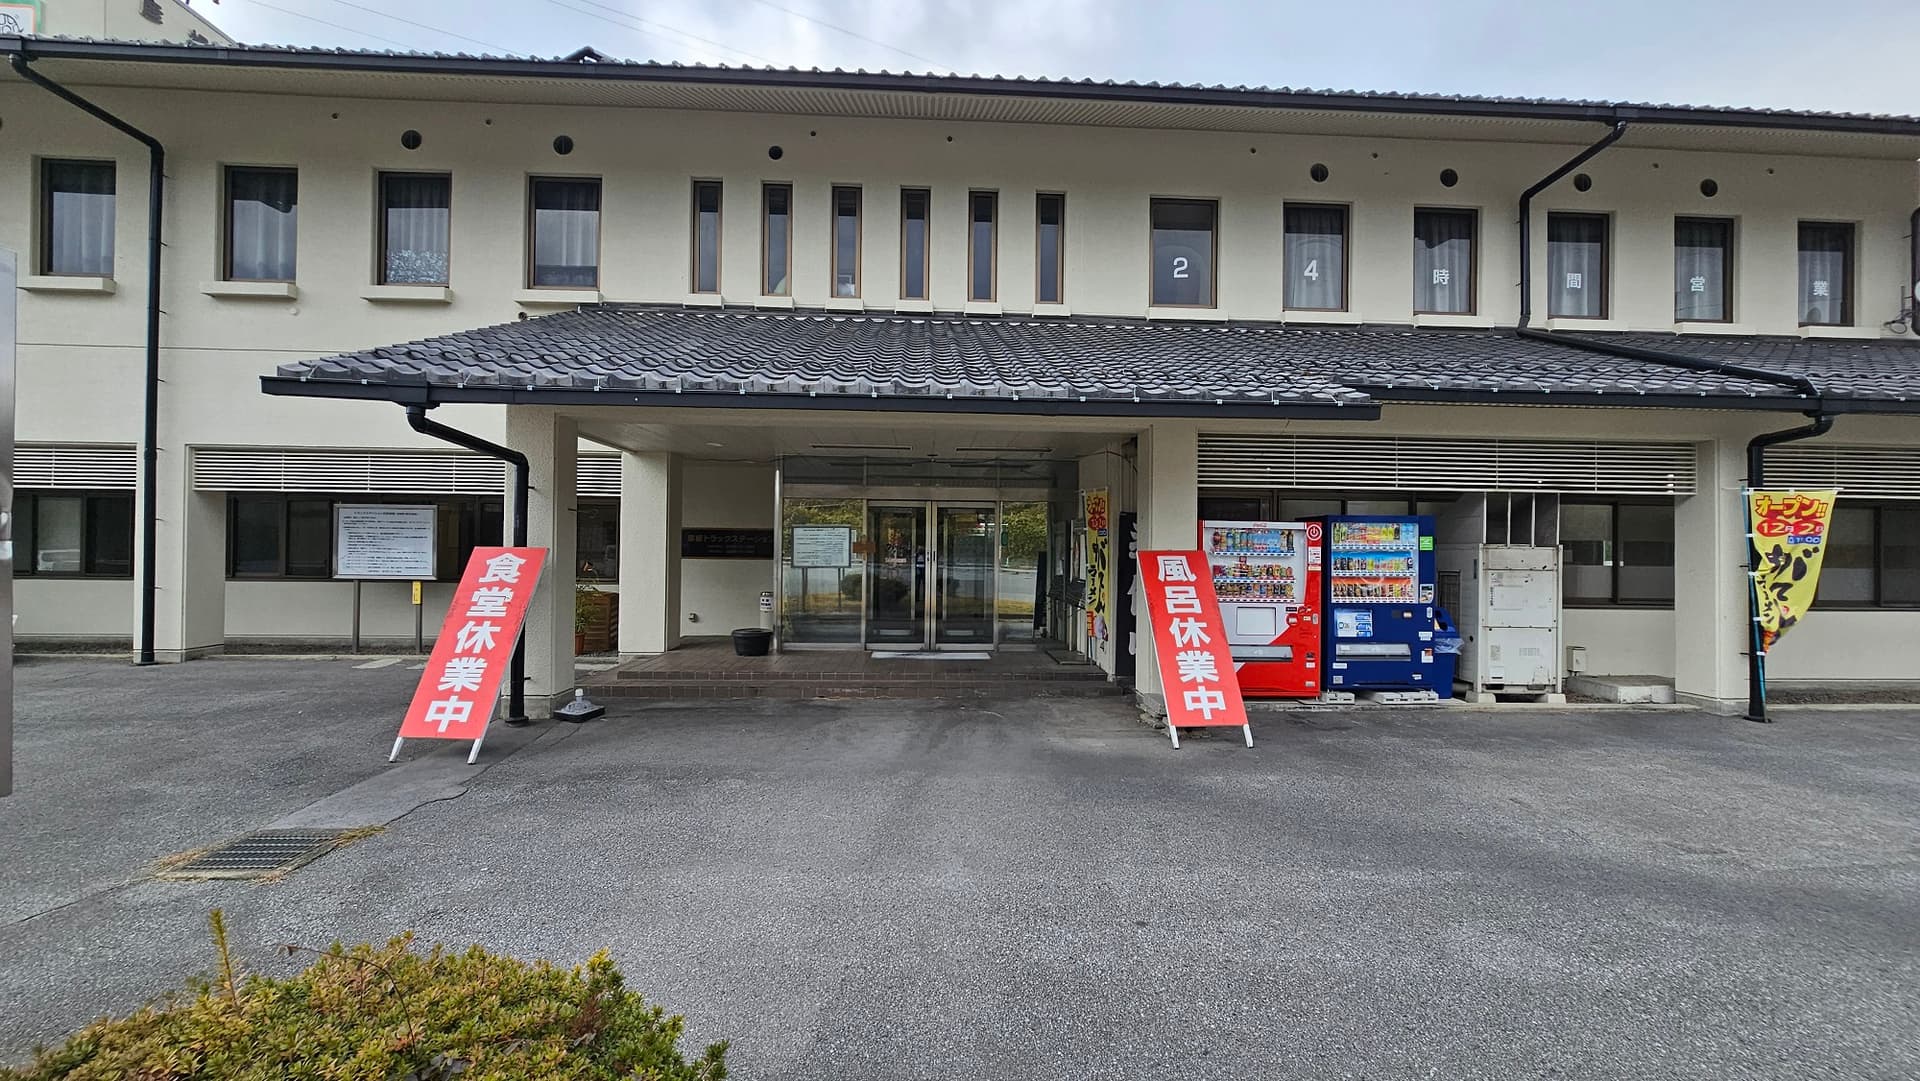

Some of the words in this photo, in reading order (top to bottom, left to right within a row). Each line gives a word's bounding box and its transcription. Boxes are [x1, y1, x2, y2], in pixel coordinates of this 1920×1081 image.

[424, 552, 526, 733] 食堂休業中
[1157, 555, 1227, 720] 風呂休業中
